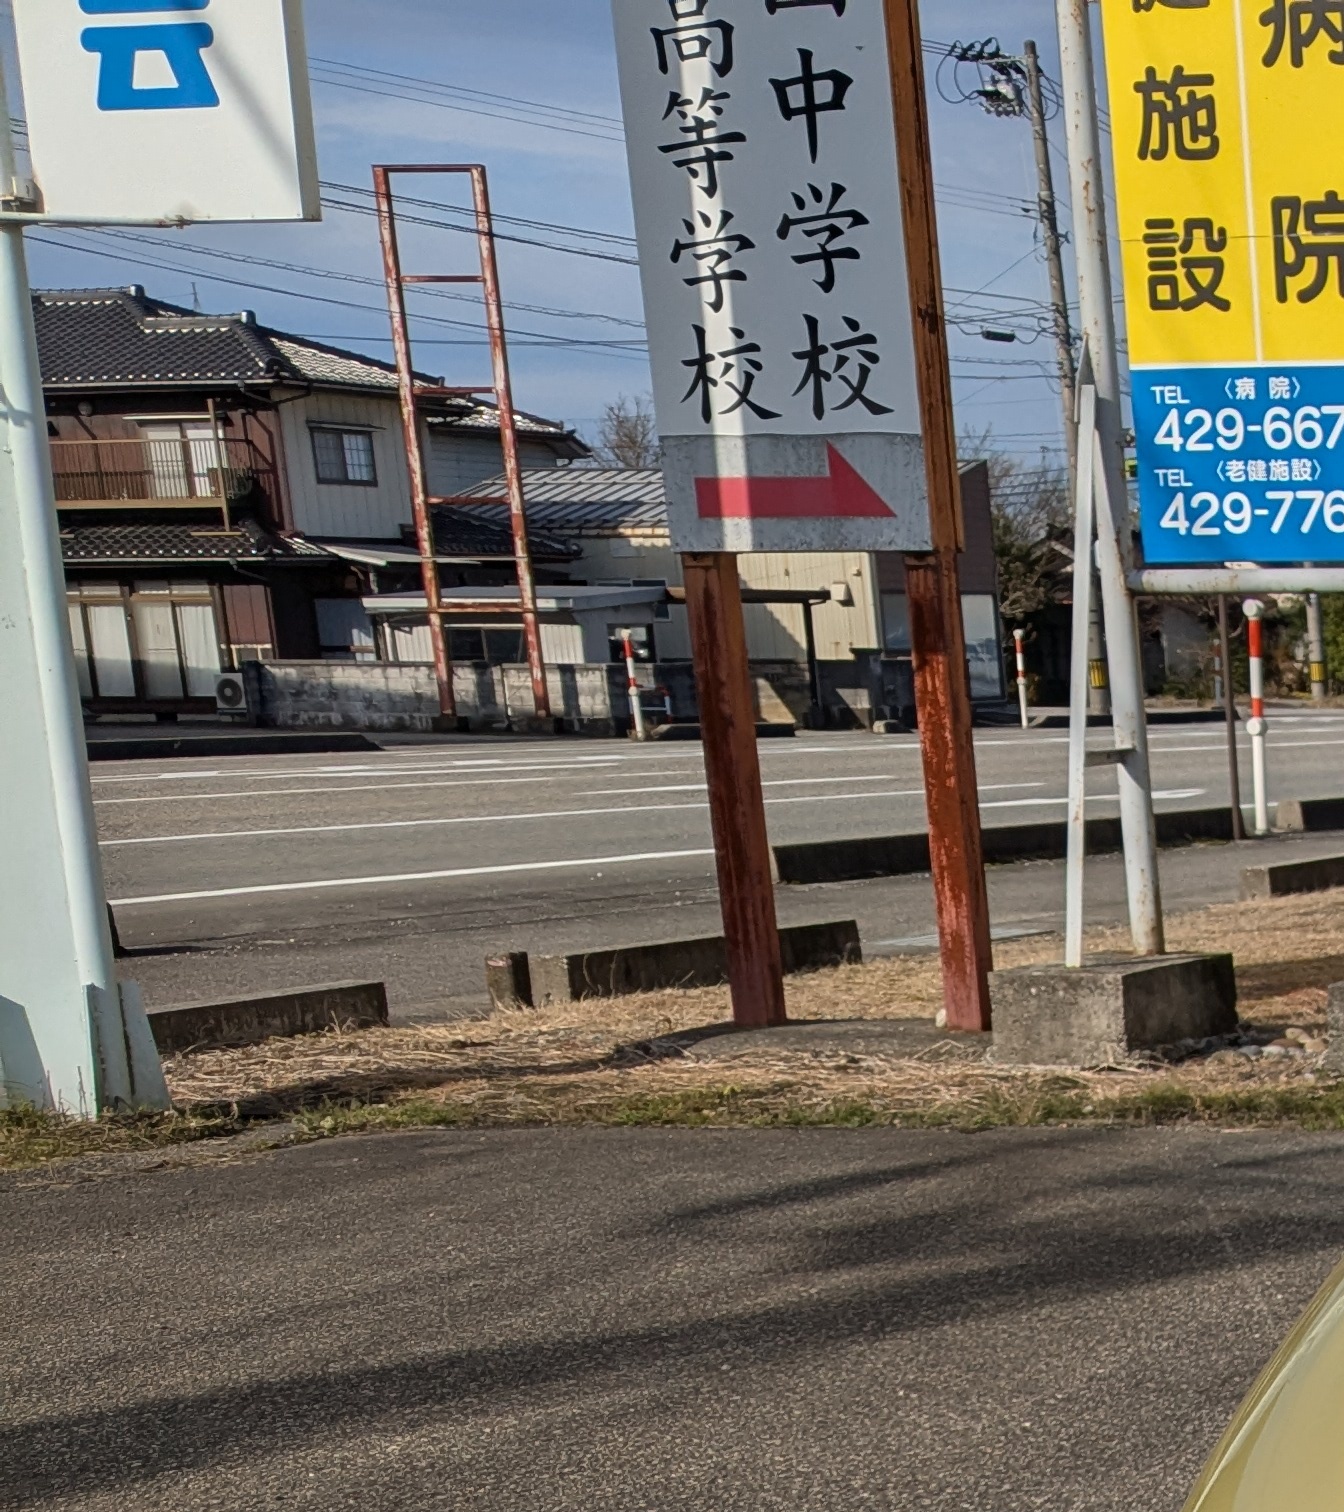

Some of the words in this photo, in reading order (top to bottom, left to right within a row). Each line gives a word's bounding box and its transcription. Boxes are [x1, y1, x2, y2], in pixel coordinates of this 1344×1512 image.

[766, 0, 895, 421] 中学校
[1131, 0, 1232, 312] 施設
[1150, 386, 1190, 404] TEL
[1154, 468, 1193, 487] TEL
